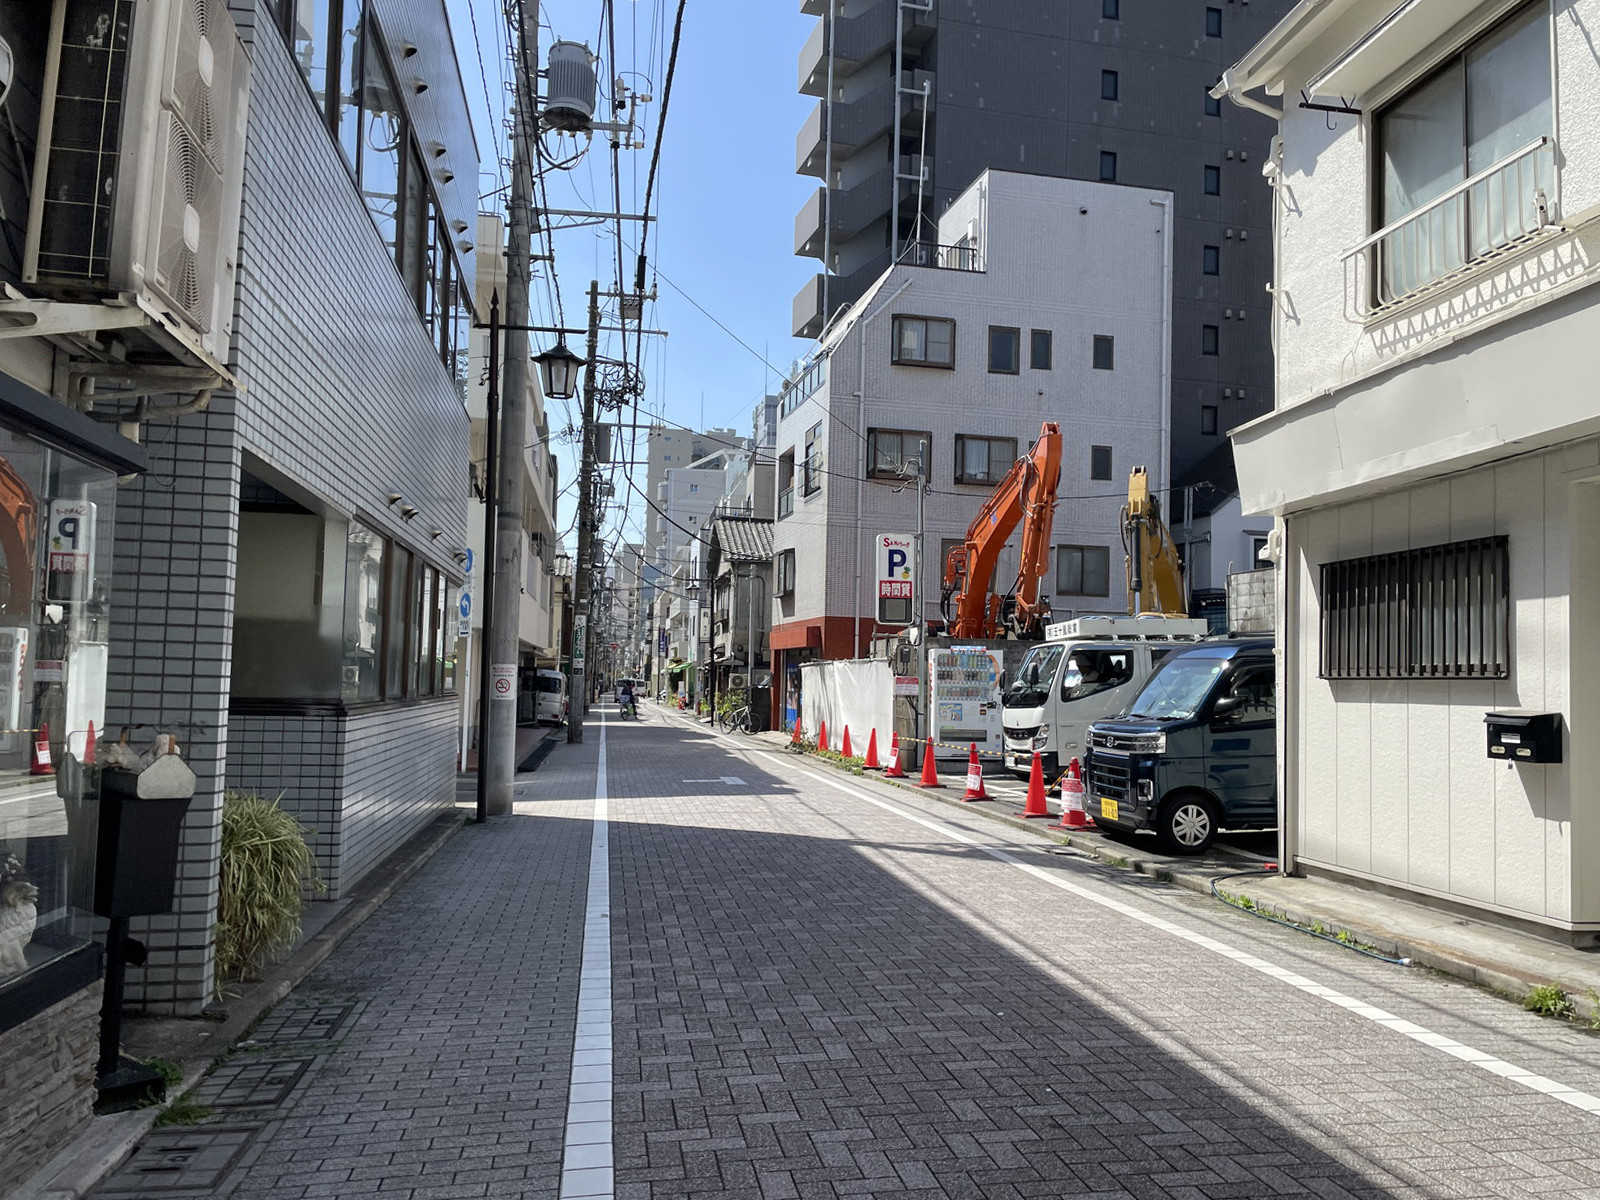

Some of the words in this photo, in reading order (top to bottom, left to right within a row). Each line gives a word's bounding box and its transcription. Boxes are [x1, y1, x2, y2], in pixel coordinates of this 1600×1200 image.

[888, 549, 907, 577] P
[881, 583, 911, 597] 時間貸
